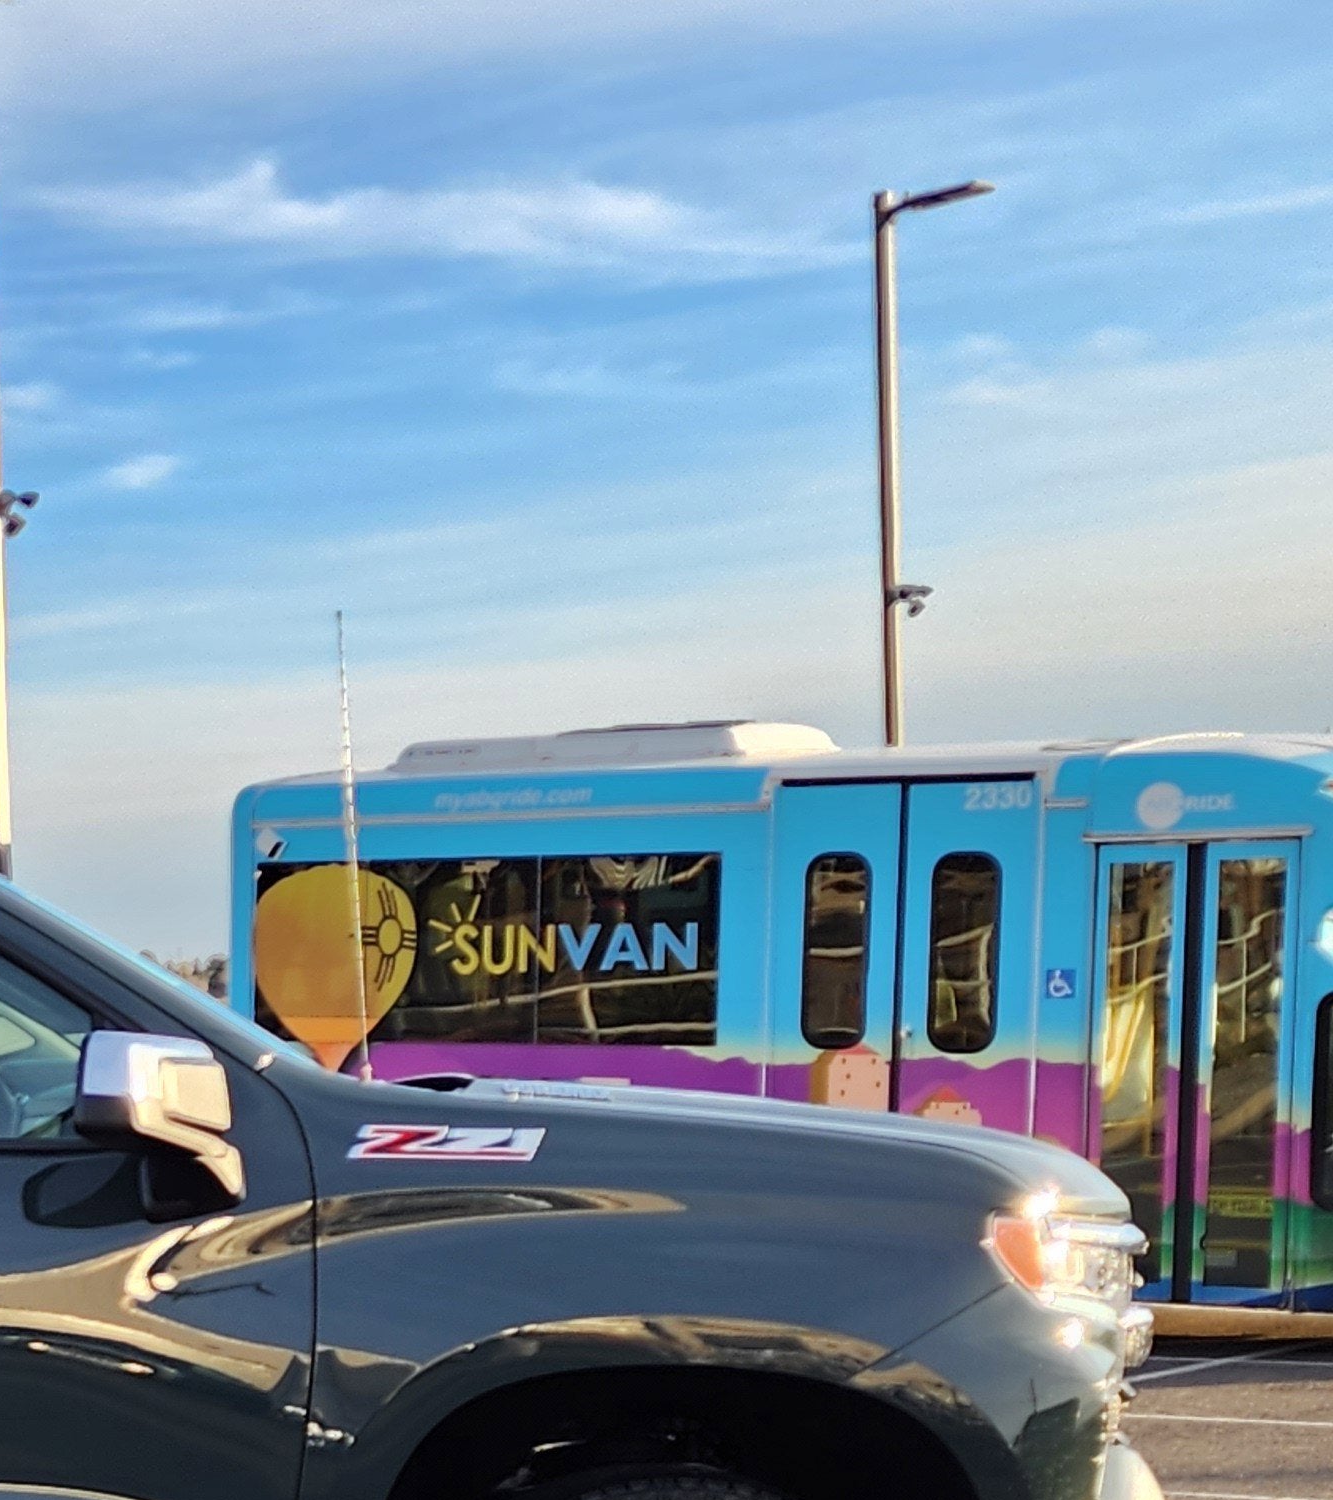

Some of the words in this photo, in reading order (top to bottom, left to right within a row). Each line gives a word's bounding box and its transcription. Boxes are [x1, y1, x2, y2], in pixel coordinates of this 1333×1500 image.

[964, 784, 1031, 810] 2330
[451, 921, 699, 976] SUNVAN
[346, 1125, 547, 1162] Z71
